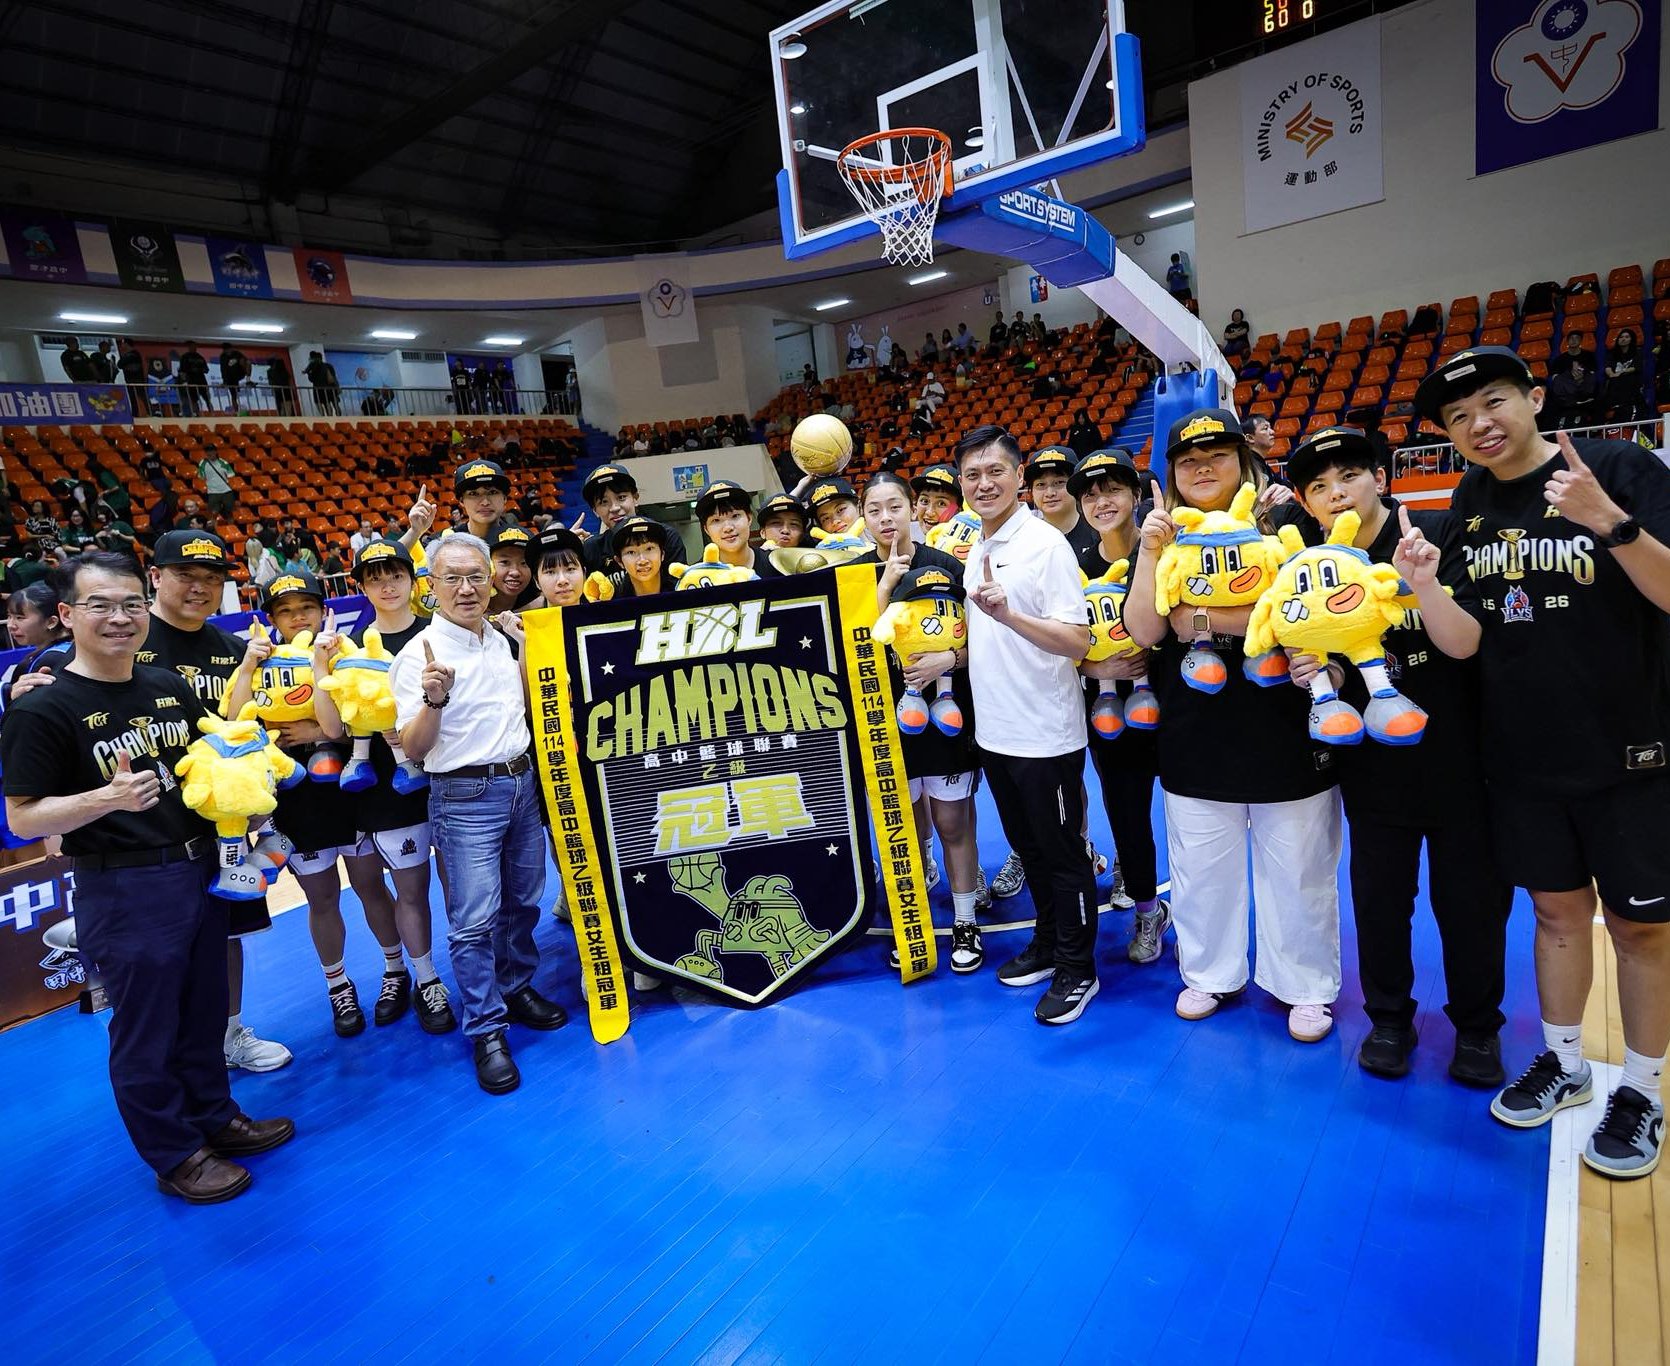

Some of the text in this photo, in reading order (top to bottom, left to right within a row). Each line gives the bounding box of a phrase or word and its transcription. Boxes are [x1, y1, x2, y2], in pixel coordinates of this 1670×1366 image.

[1264, 9, 1288, 33] 60
[1257, 73, 1364, 161] MINISTRY OF SPORTS
[1284, 160, 1338, 186] 運動部
[1545, 596, 1569, 608] 26
[635, 598, 778, 665] HBL
[1407, 650, 1428, 667] 26
[586, 662, 847, 762] CHAMPIONS
[643, 734, 798, 769] 高中籃球聯賽
[702, 759, 746, 779] 乙級
[650, 771, 816, 855] 冠軍
